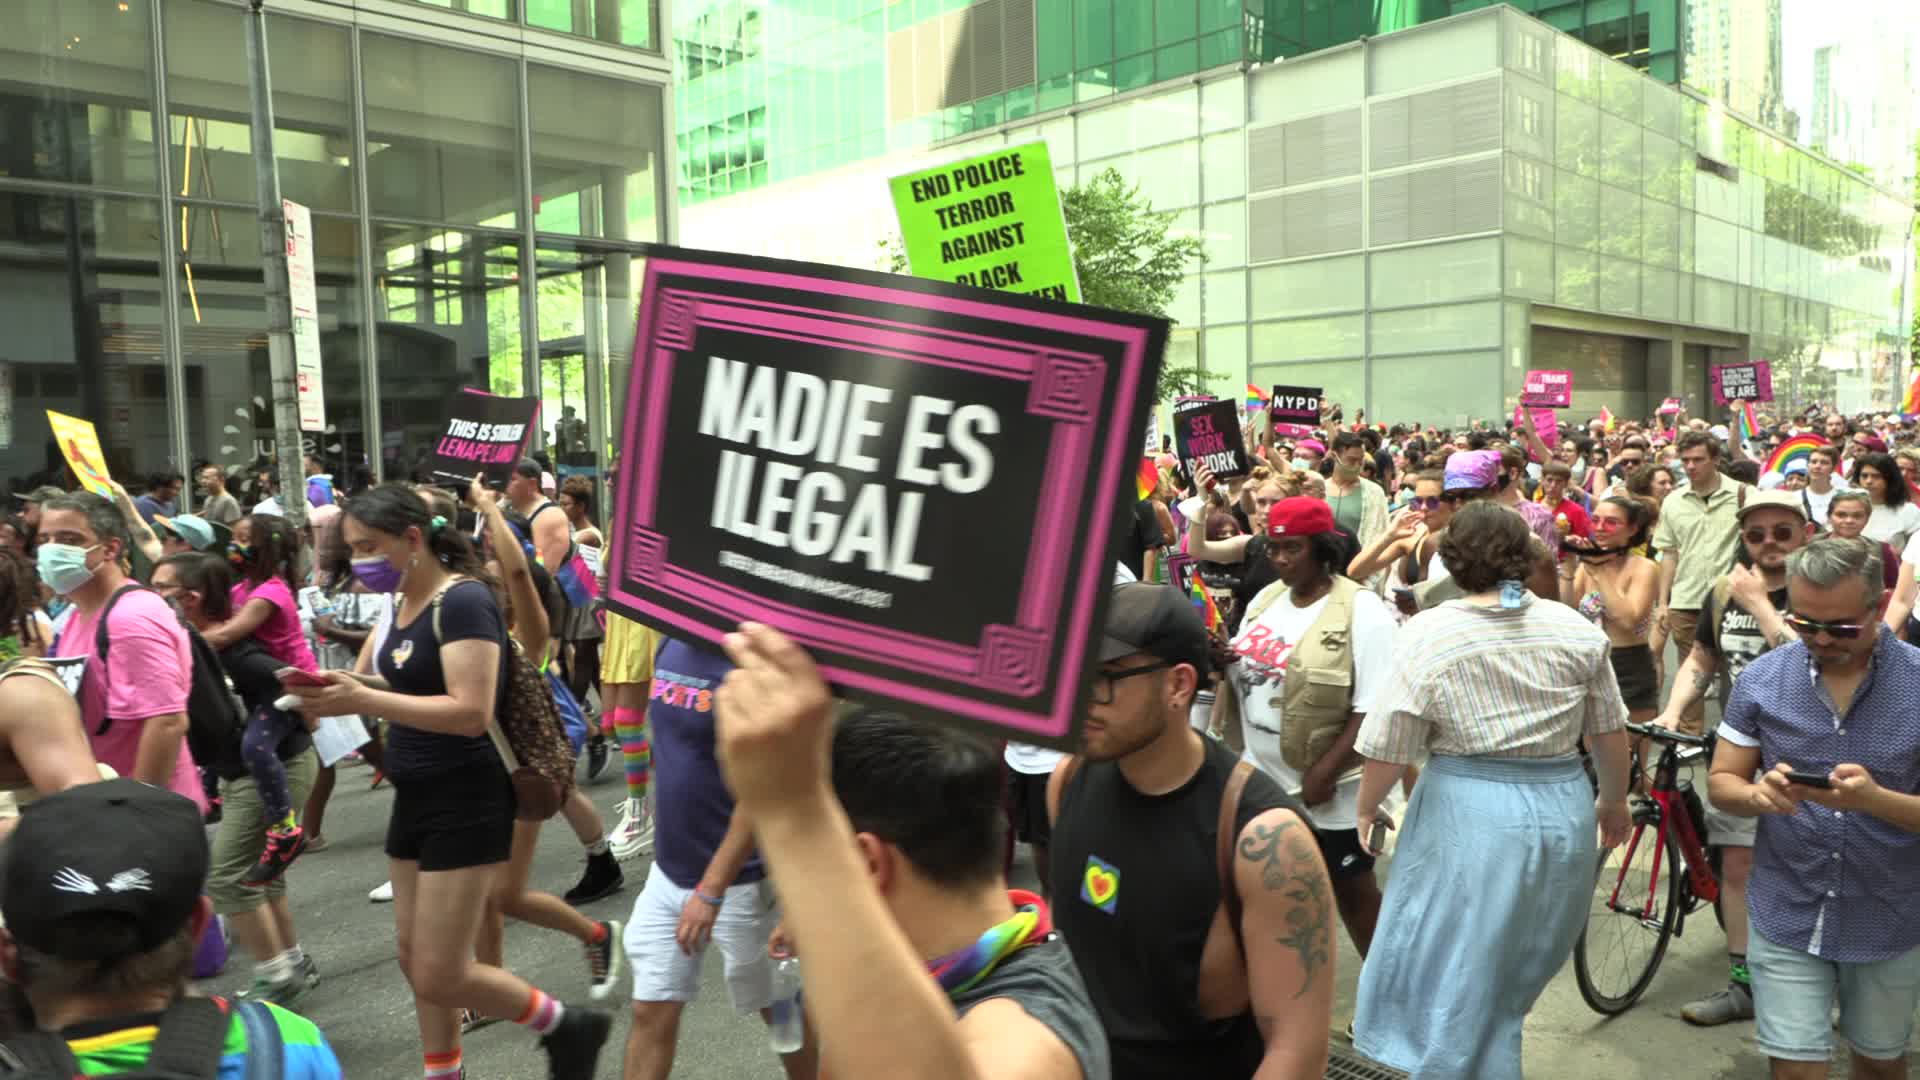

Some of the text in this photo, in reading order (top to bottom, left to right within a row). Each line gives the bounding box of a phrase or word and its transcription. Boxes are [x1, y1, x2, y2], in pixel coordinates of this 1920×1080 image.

[911, 153, 1024, 203] END POLICE
[935, 191, 1015, 230] TERROR
[941, 222, 1024, 264] AGAINST
[1273, 395, 1318, 411] NYPD
[1723, 384, 1757, 399] WE ARE
[447, 418, 479, 439] THIS
[476, 423, 493, 441] IS
[697, 356, 1000, 493] NADIE ES
[1190, 415, 1215, 437] SEX
[248, 439, 316, 462] jue
[437, 436, 493, 463] LENAPE
[1188, 432, 1225, 457] WORK
[711, 449, 934, 582] ILEGAL
